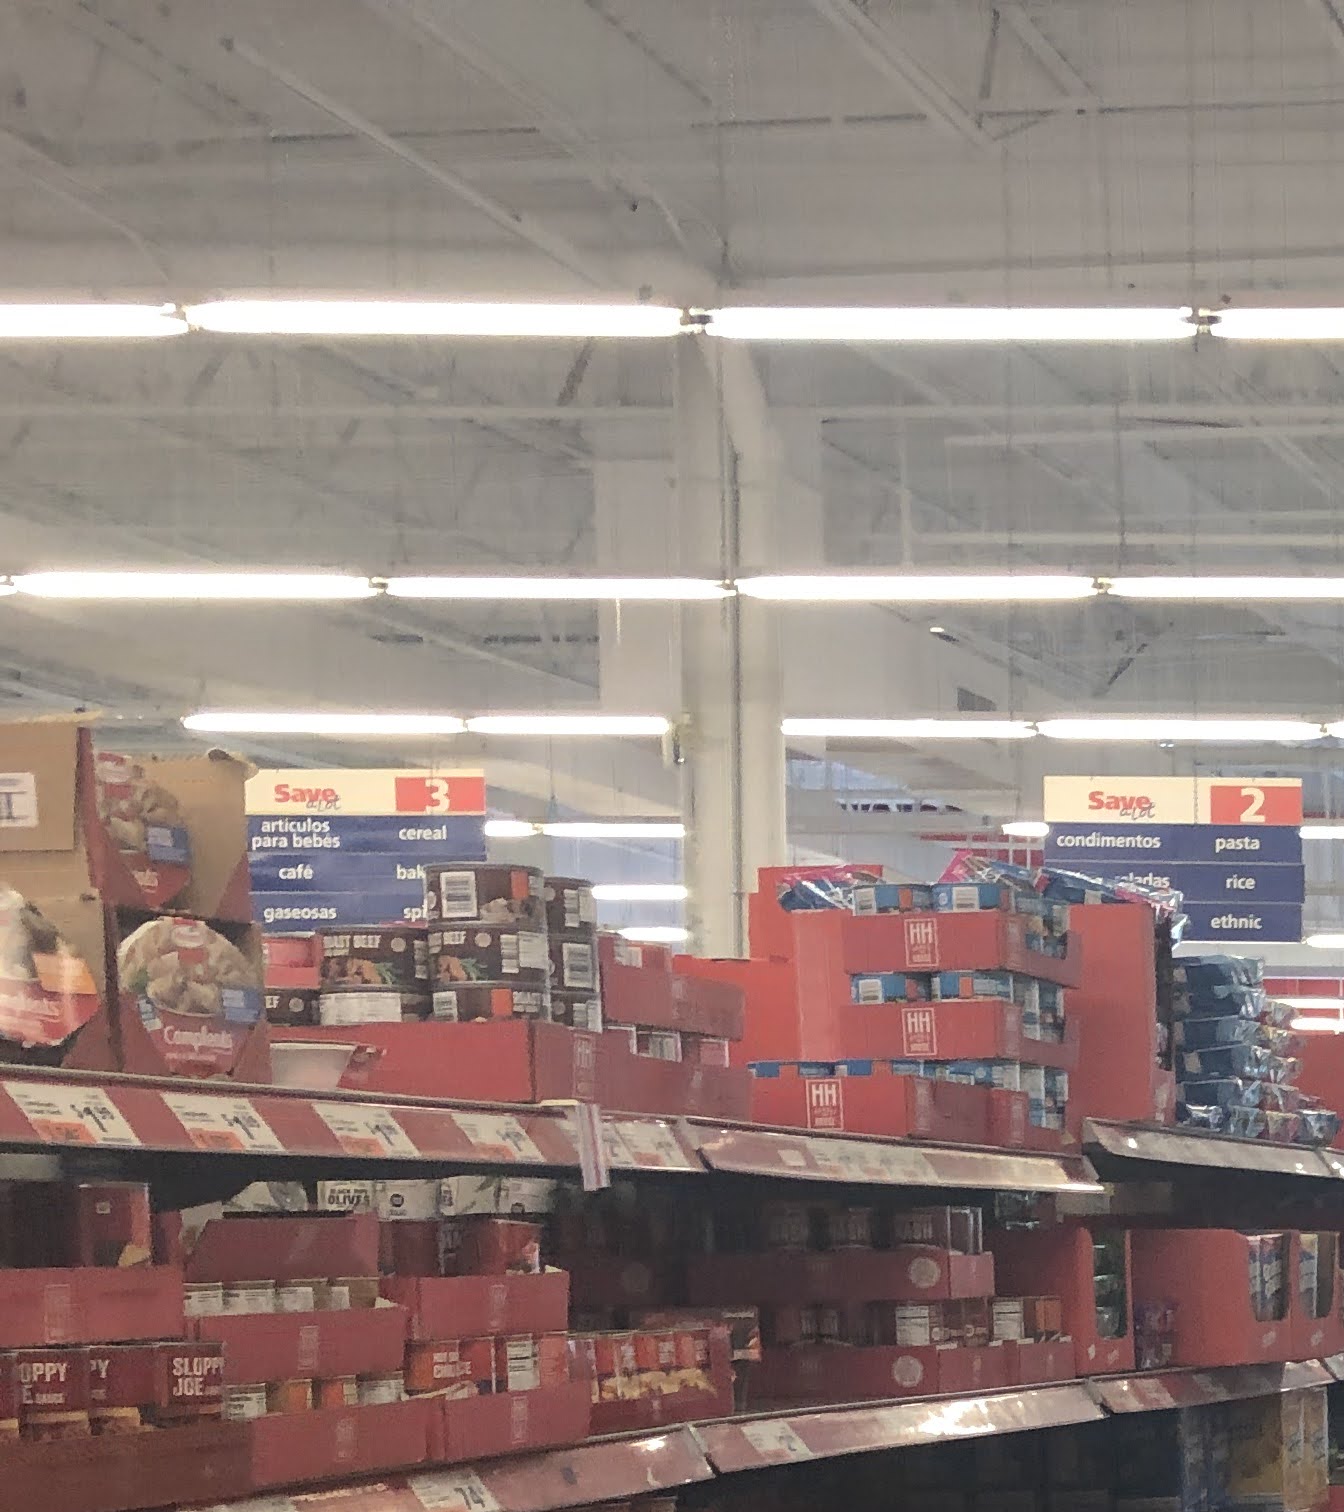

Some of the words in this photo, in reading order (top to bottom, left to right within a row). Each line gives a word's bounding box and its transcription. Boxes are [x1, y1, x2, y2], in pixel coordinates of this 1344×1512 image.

[274, 784, 336, 803] Save
[425, 779, 450, 814] 3
[1088, 791, 1151, 811] Save
[1239, 787, 1266, 823] 2
[399, 825, 447, 840] cereal
[1056, 832, 1162, 849] condimentos
[252, 836, 288, 850] para
[1215, 836, 1261, 853] pasta
[278, 864, 314, 880] café
[396, 865, 427, 880] bak
[1225, 874, 1256, 890] rice
[263, 907, 337, 923] gaseosas
[403, 903, 428, 923] spi
[1210, 913, 1263, 930] ethnic
[811, 1083, 837, 1107] HH
[19, 1362, 68, 1383] OPPY
